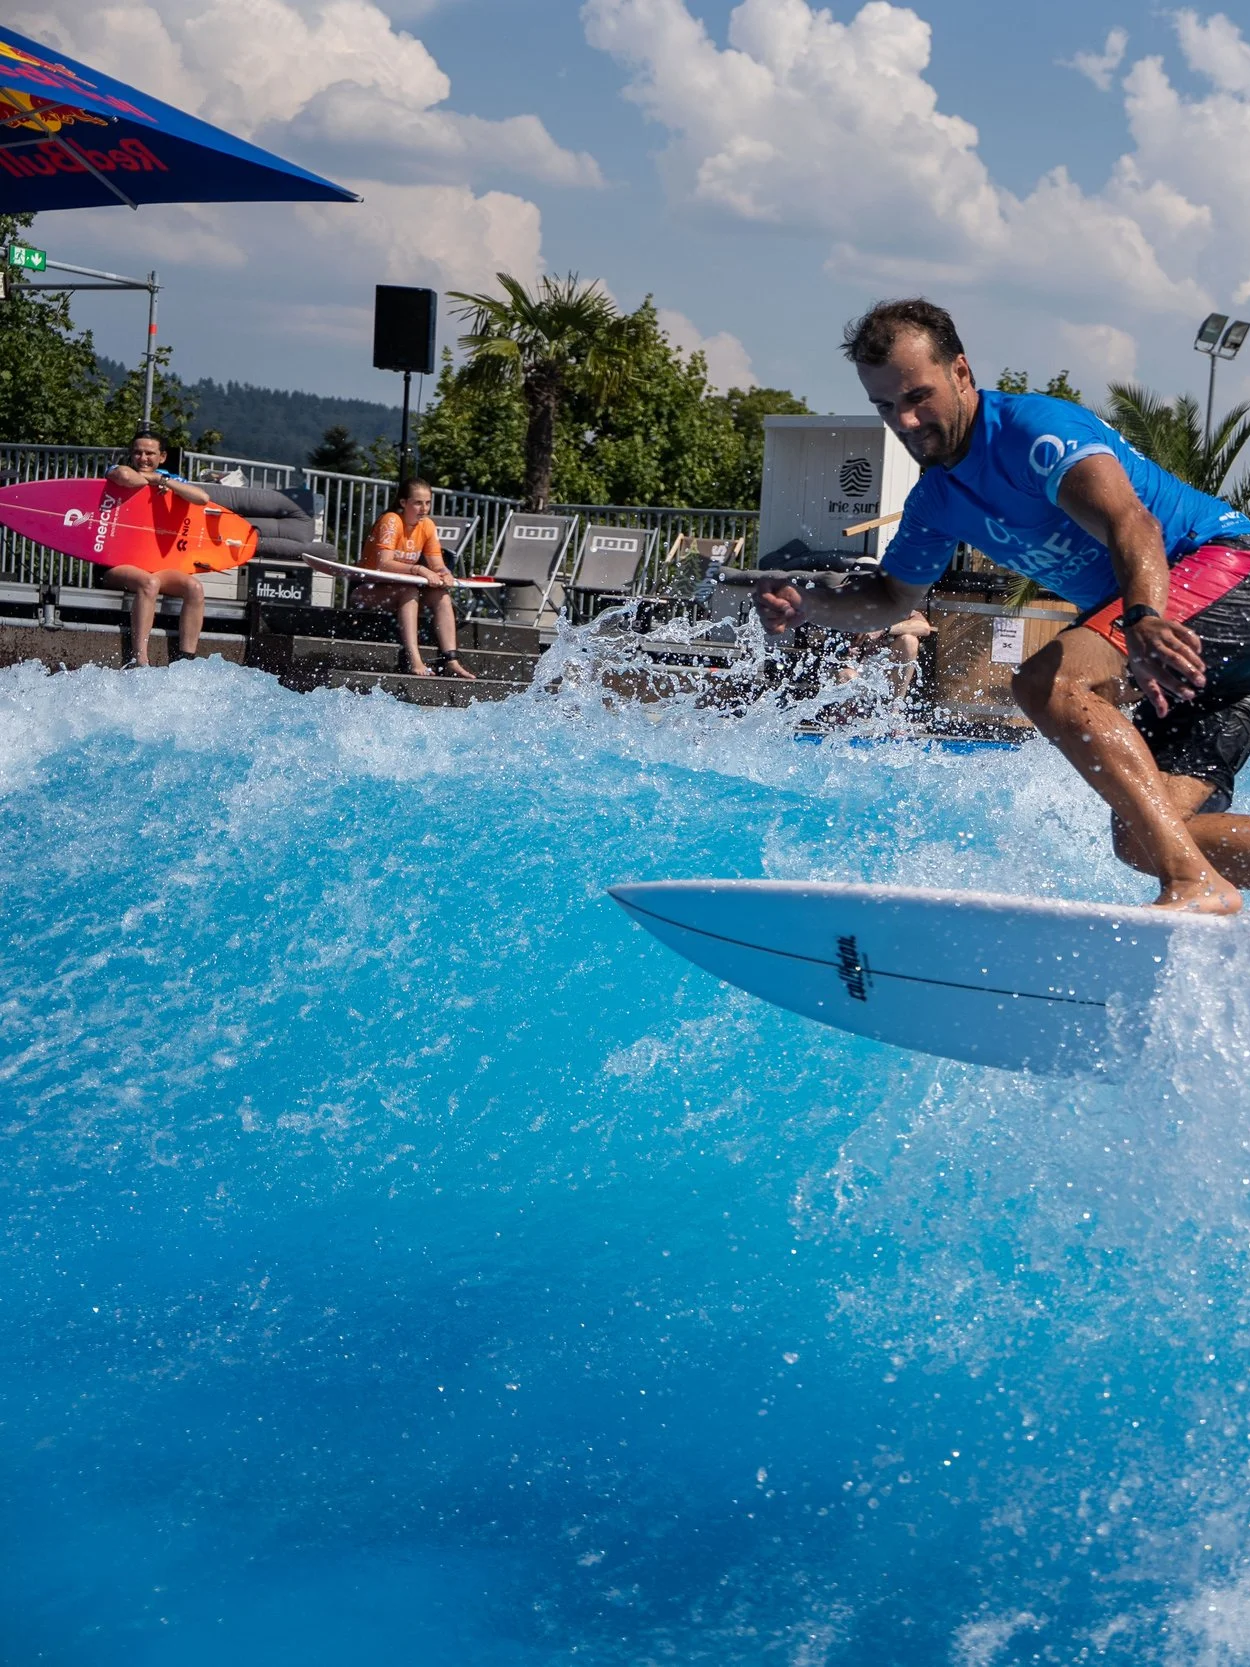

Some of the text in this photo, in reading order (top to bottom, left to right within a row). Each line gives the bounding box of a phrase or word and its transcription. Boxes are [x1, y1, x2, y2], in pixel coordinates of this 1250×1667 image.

[828, 500, 849, 513] irie
[94, 493, 116, 553] enercity
[181, 518, 191, 537] NIO
[256, 582, 302, 600] fritz-kola
